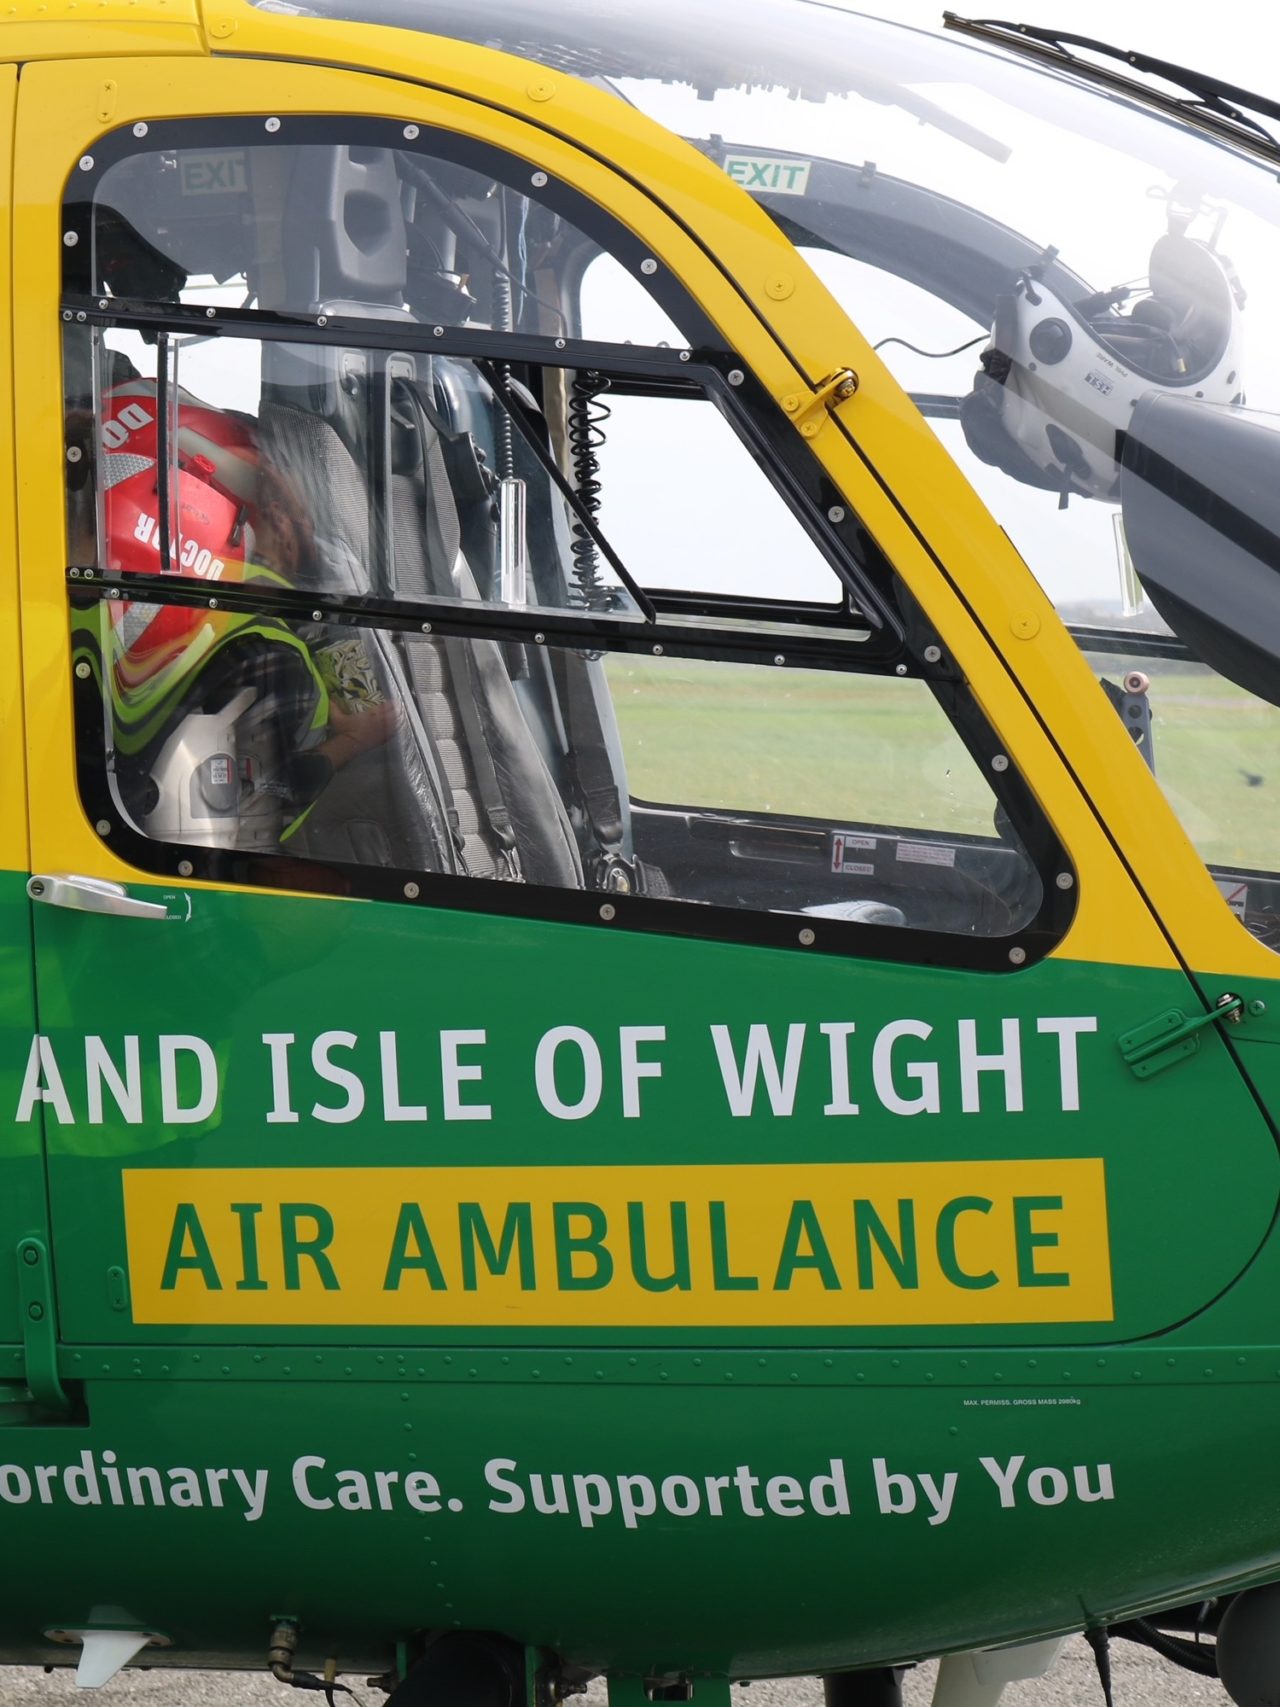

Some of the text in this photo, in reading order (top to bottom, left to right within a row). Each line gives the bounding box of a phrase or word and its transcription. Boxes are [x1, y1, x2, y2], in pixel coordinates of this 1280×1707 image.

[727, 161, 805, 189] EXIT
[16, 1035, 218, 1125] AND
[263, 1030, 492, 1124] ISLE
[535, 1025, 667, 1120] OF
[710, 1017, 1098, 1117] WIGHT
[162, 1196, 1070, 1293] AIR AMBULANCE
[292, 1455, 463, 1515] Care.
[485, 1458, 851, 1529] Supported
[872, 1457, 959, 1526] by
[979, 1455, 1115, 1508] You
